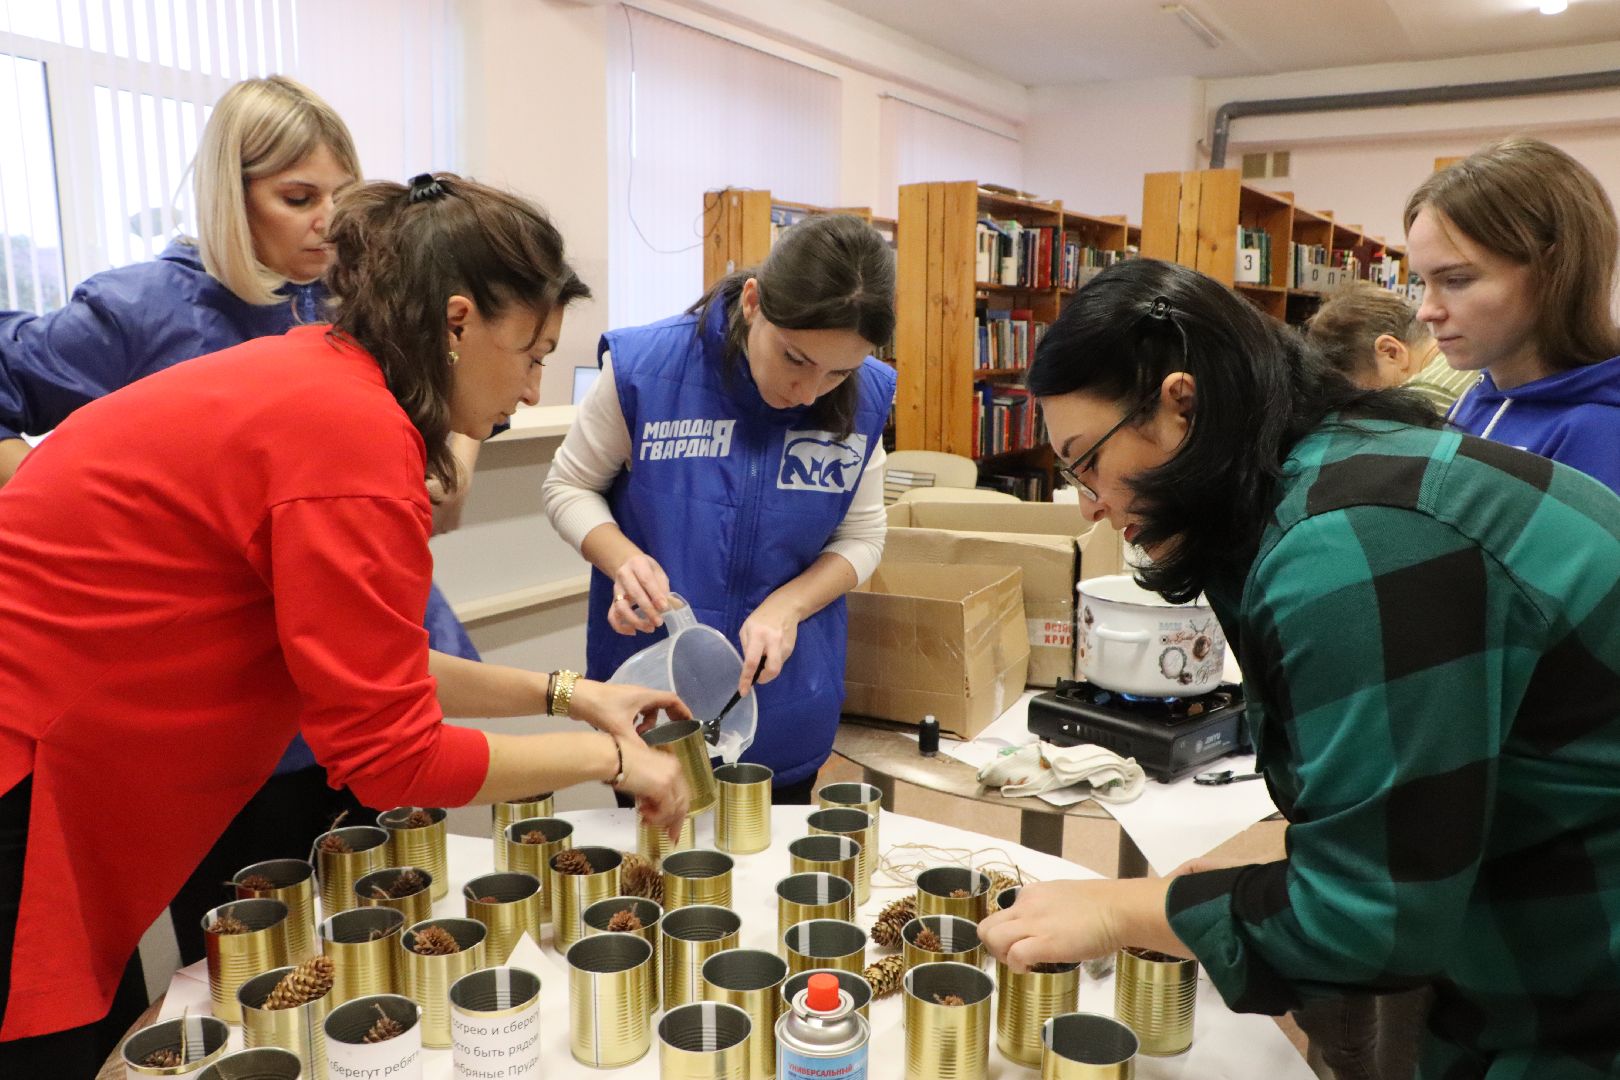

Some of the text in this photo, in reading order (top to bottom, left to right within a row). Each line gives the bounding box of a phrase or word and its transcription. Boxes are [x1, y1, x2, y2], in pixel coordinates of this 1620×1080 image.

[640, 431, 735, 460] ГВАРДИЯ
[643, 419, 736, 446] МОЛОДАЯ
[474, 1046, 505, 1058] быть
